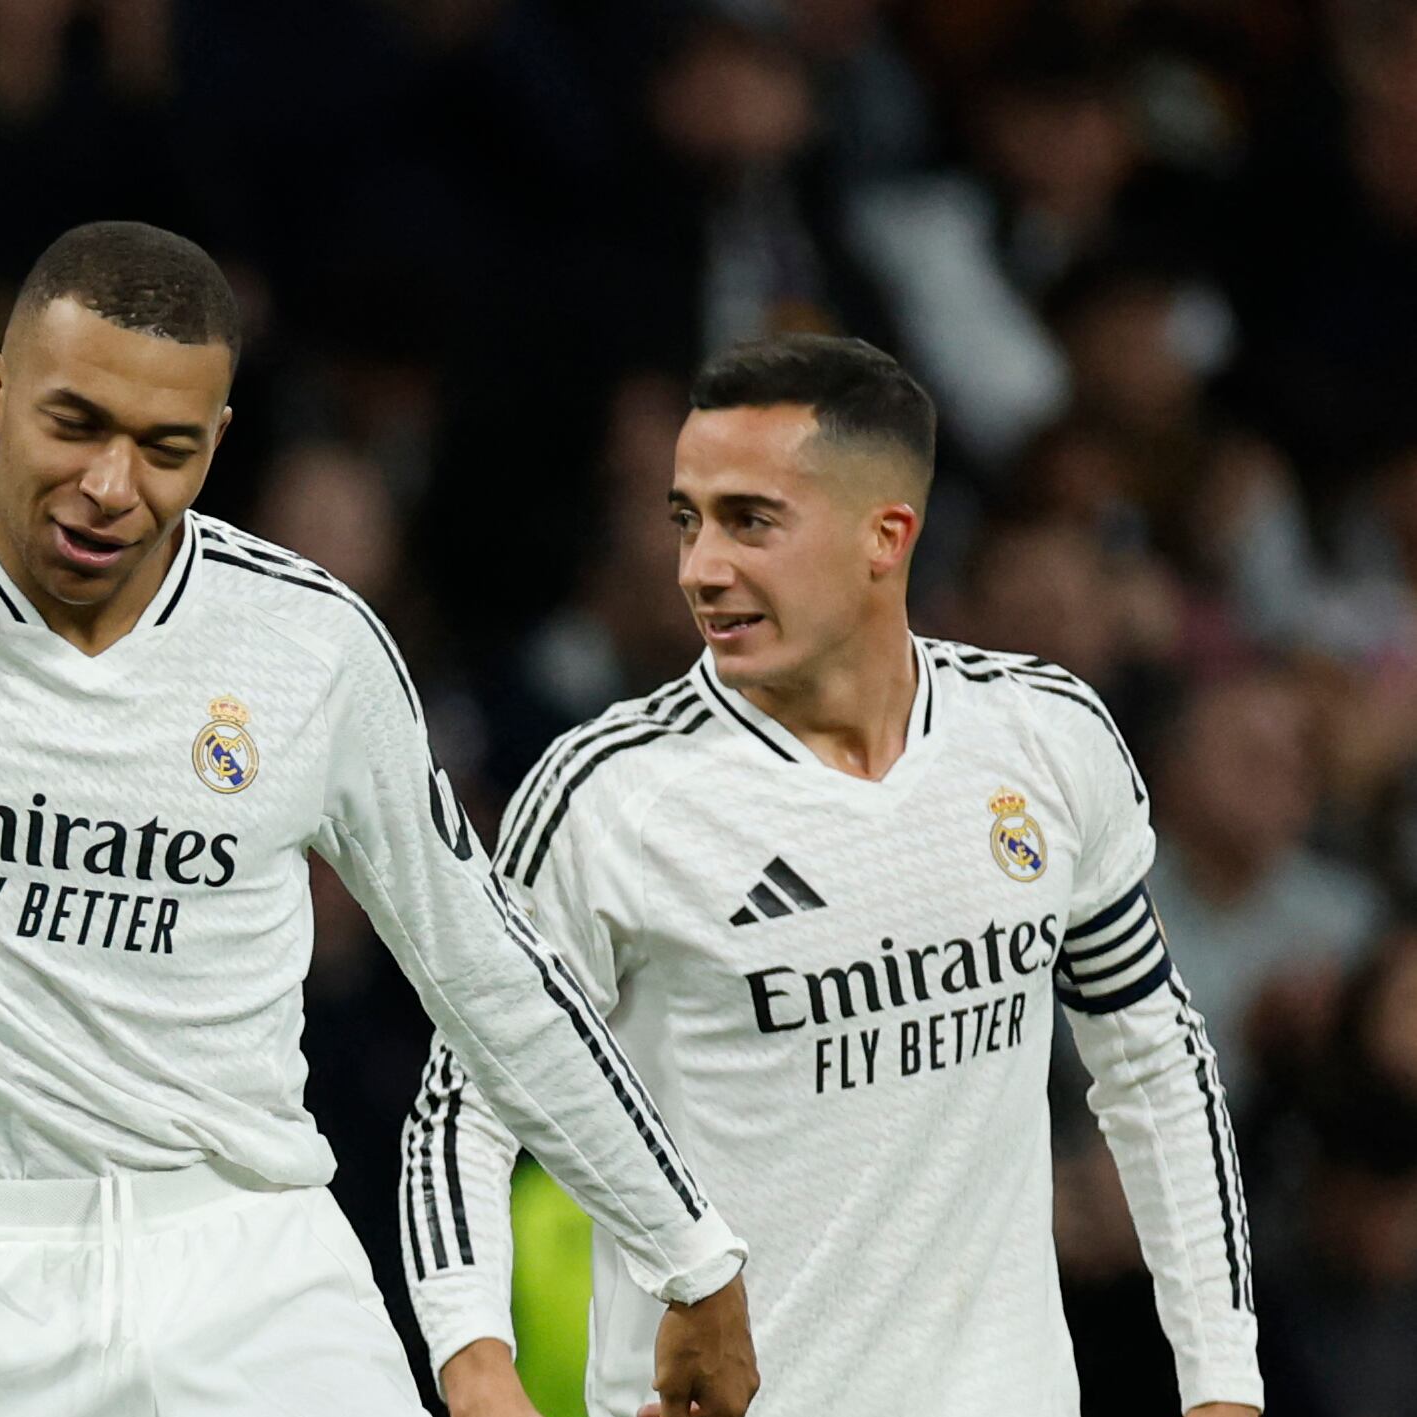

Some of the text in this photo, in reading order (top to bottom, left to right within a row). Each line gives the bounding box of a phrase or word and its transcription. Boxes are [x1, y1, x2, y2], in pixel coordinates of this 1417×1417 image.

[16, 882, 180, 954] BETTER
[745, 913, 1057, 1033] Emirates
[816, 992, 1025, 1094] FLY BETTER
